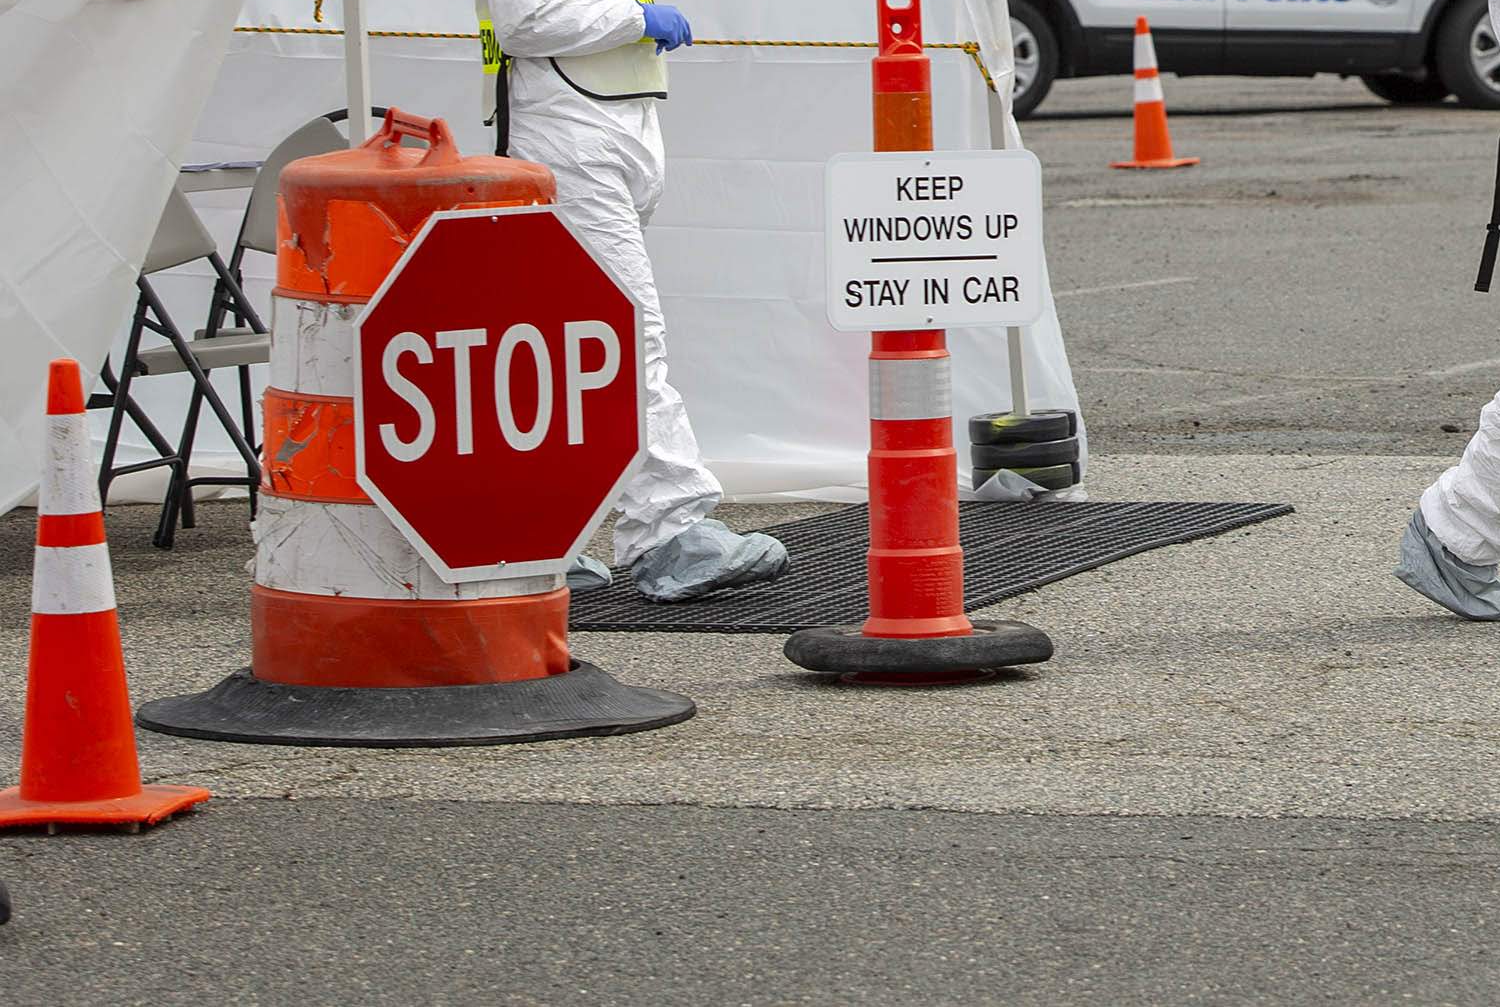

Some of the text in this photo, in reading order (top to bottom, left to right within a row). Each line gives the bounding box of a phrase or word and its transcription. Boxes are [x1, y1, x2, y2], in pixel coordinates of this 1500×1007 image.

[895, 176, 964, 202] KEEP
[843, 213, 1019, 243] WINDOWS UP
[844, 275, 1020, 308] STAY IN CAR
[378, 319, 622, 463] STOP
